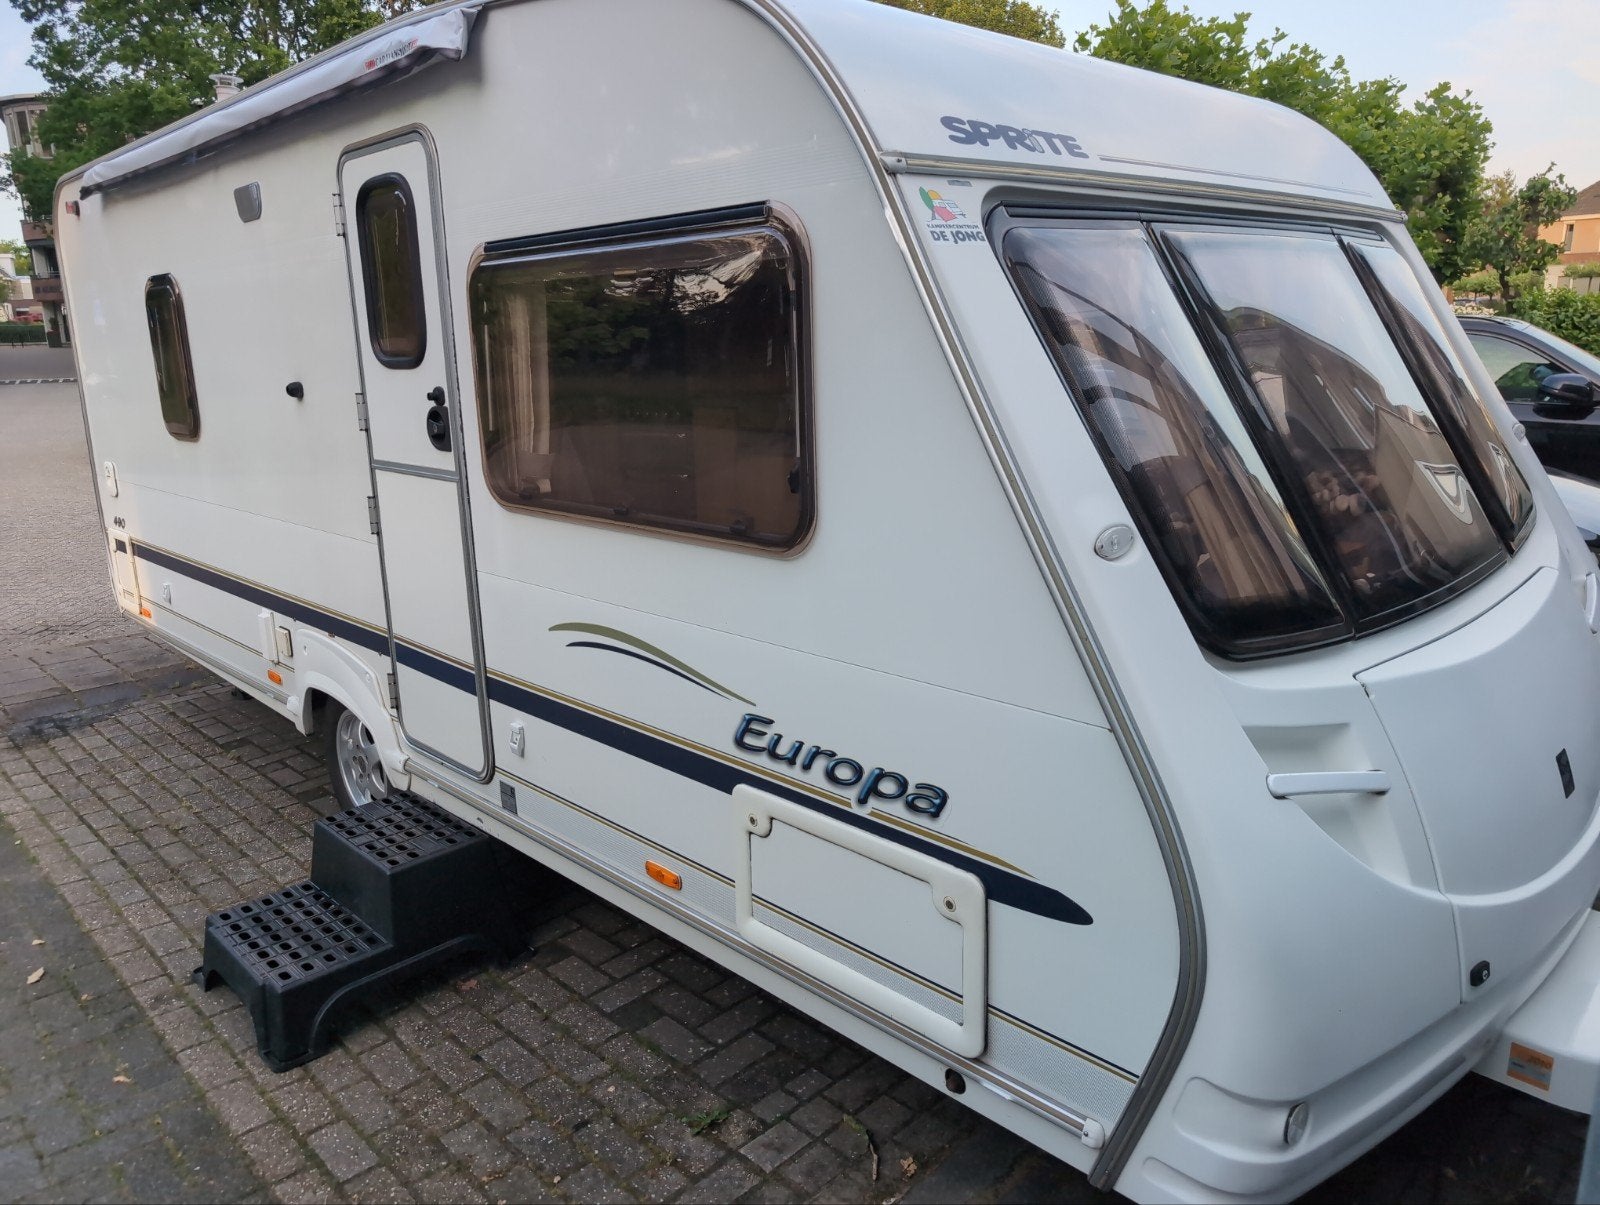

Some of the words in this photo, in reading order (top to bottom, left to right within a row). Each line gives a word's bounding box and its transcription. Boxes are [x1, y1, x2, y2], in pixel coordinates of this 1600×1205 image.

[930, 230, 950, 242] DE
[950, 230, 987, 245] JONG
[734, 713, 950, 818] Europa
